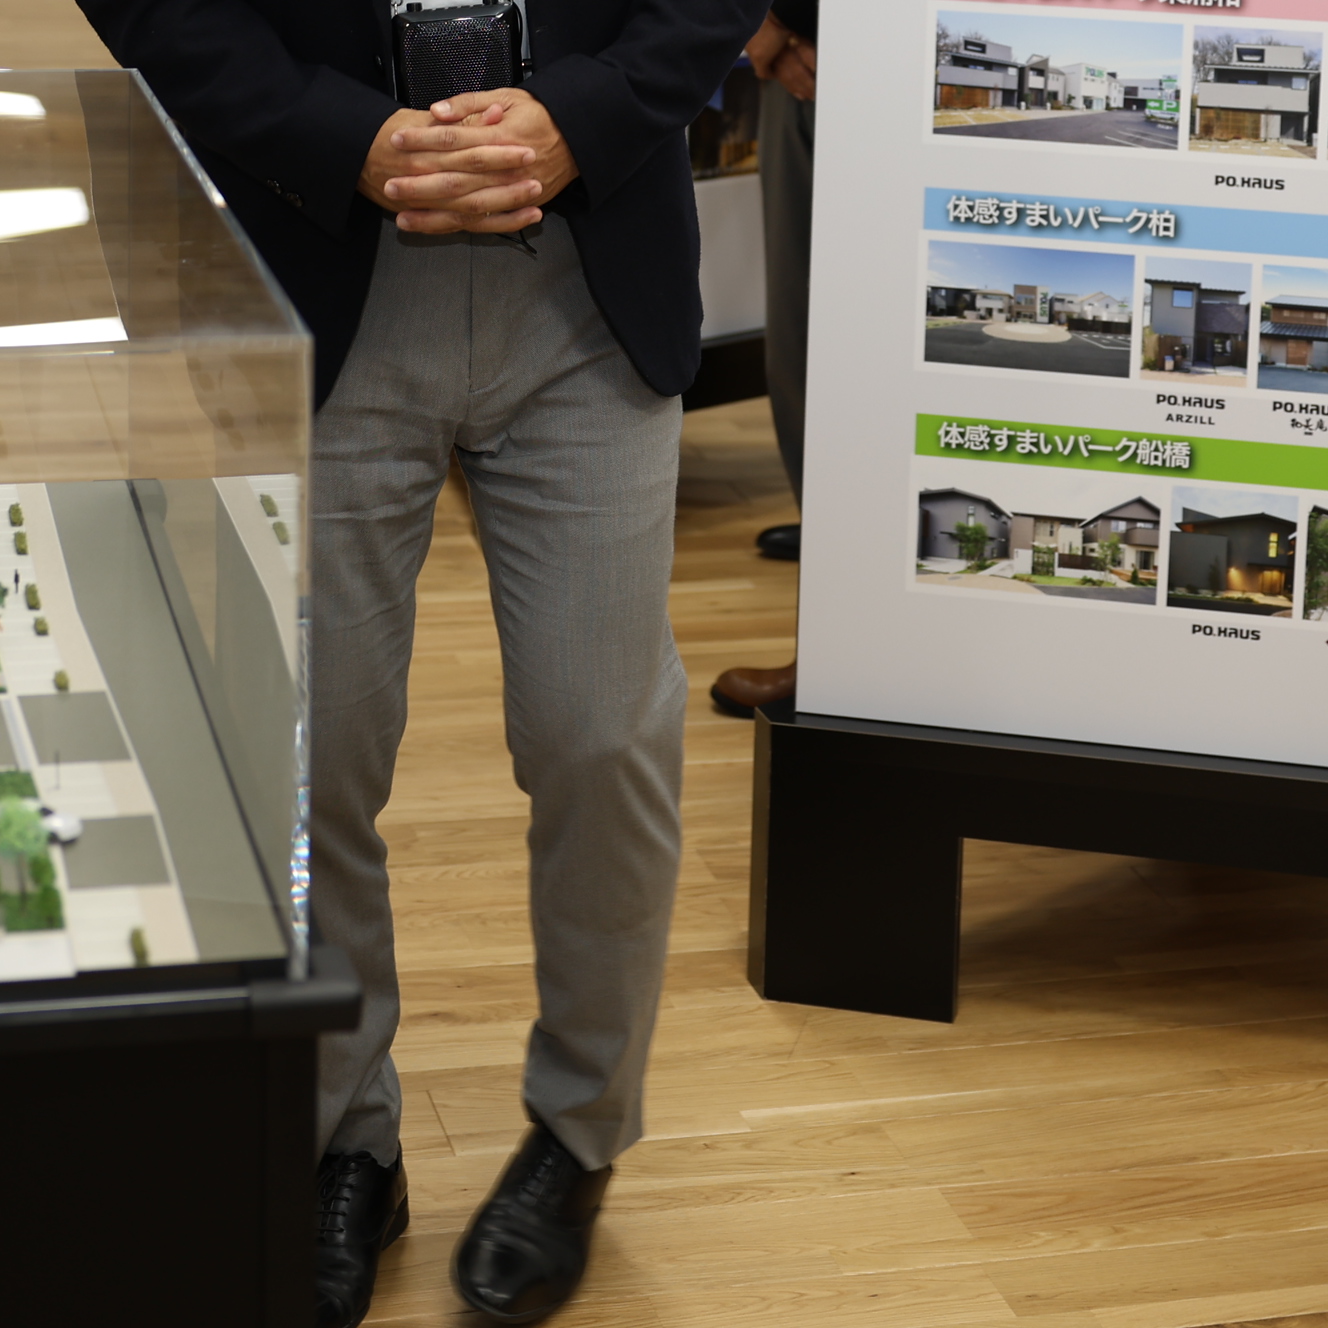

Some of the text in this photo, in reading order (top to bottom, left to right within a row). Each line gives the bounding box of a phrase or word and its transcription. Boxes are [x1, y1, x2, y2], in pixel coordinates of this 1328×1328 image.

[945, 194, 1177, 238] 体感すまいパーク柏
[1165, 412, 1216, 426] ARZILL
[937, 421, 1192, 469] 体感すまいパーク船橋
